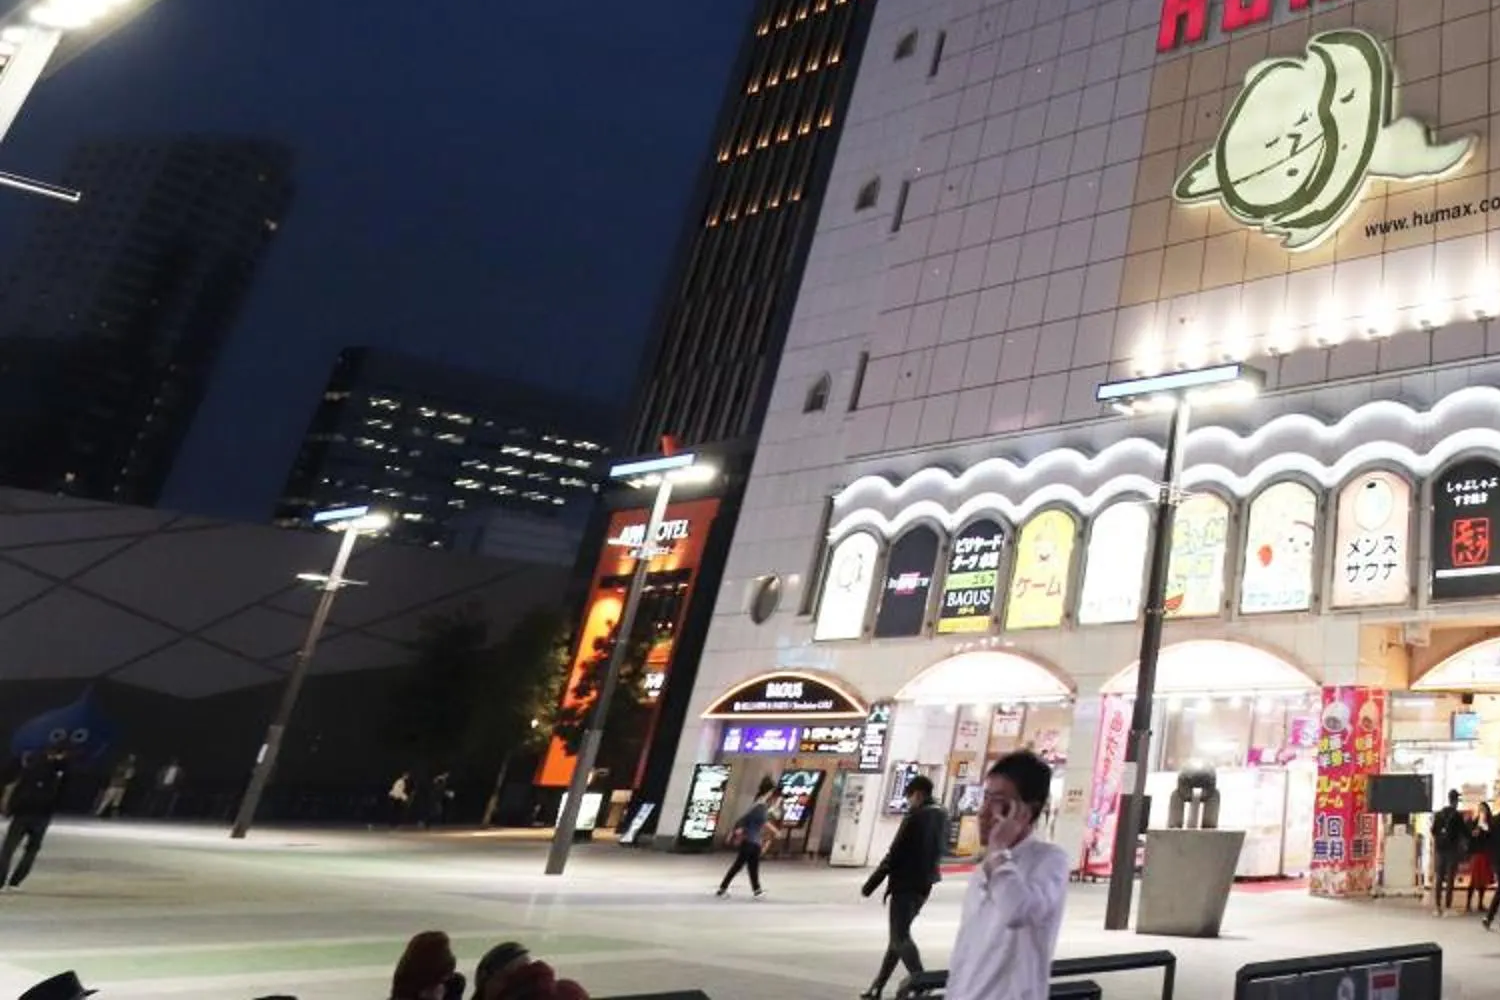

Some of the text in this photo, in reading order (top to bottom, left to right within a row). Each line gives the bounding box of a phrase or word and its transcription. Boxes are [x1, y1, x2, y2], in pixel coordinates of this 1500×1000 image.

[1346, 562, 1398, 580] サウナ
[947, 589, 991, 607] BAGUS
